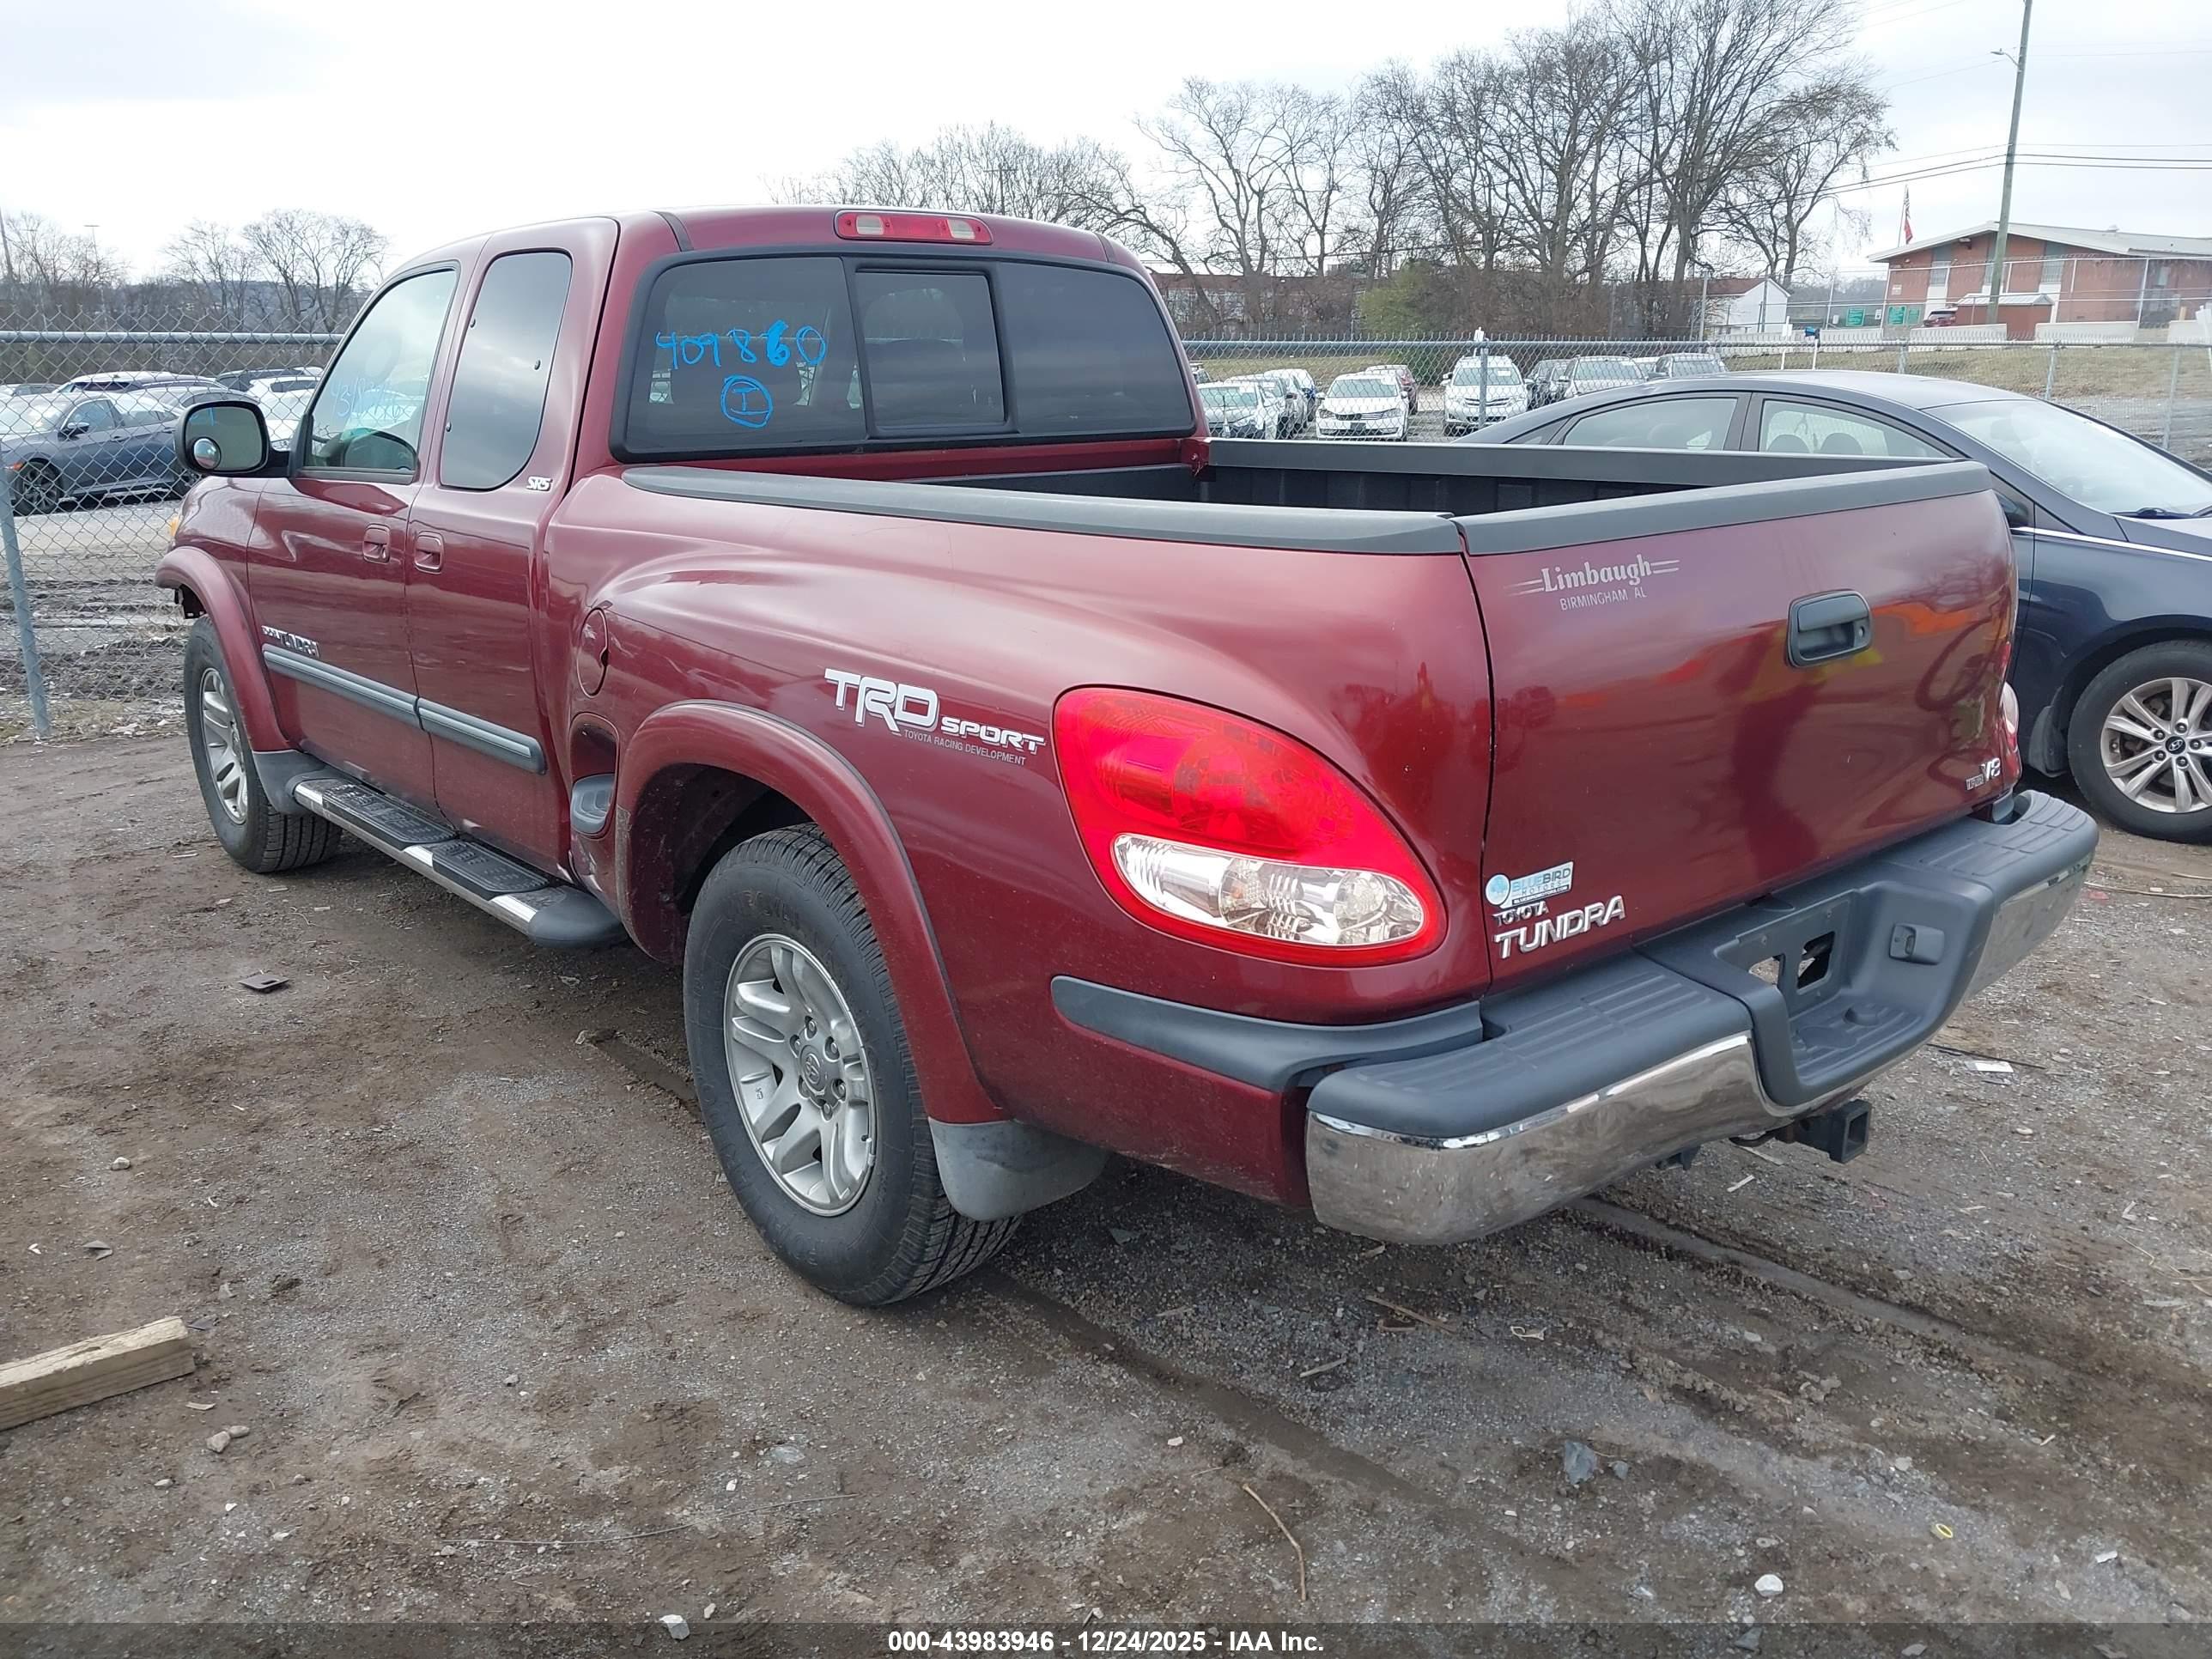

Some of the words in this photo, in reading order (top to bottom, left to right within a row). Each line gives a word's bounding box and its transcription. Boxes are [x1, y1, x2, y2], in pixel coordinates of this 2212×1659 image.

[1541, 554, 1652, 592] Limbaugh
[1634, 586, 1647, 599] AL
[824, 668, 939, 736] TRD
[904, 730, 933, 744] TOYOTA
[933, 737, 963, 751] RACING
[964, 744, 1026, 765] DEVELOPMENT
[941, 716, 1046, 754] SPORT
[1980, 757, 2001, 781] V8
[1493, 901, 1549, 927] TOYOTA
[1494, 895, 1626, 959] TUNDRA
